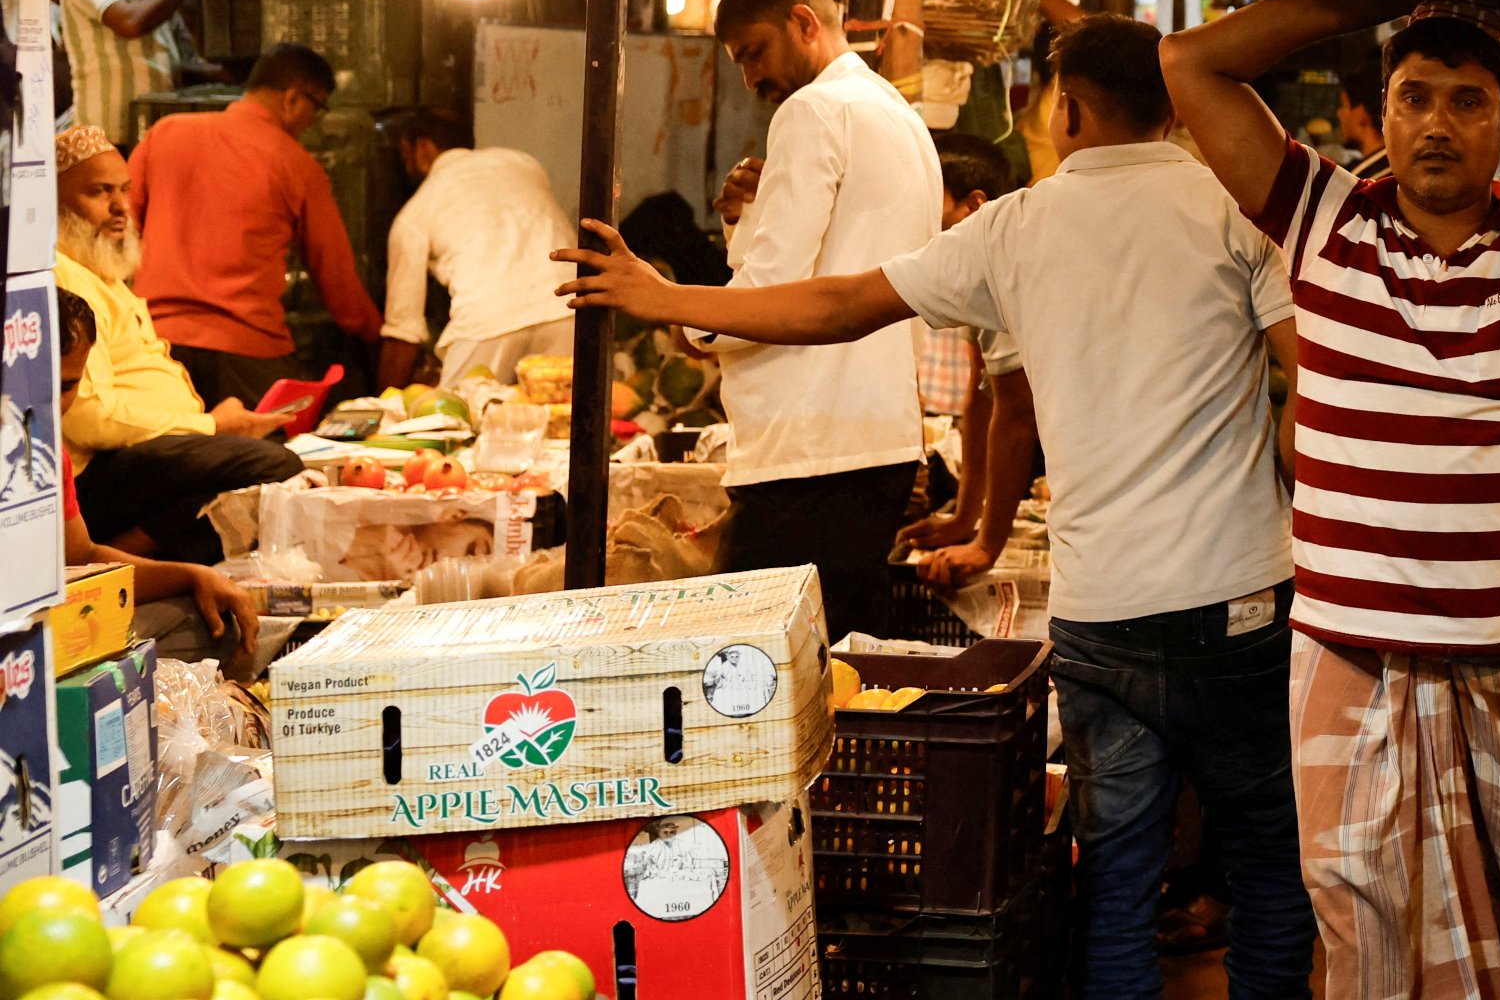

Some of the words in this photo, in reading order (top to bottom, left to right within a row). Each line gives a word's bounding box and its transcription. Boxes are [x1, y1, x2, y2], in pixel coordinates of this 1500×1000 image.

[287, 708, 335, 719] Produce
[732, 704, 751, 712] 1960
[283, 725, 295, 736] Of
[299, 723, 341, 736] Türkiye
[475, 731, 511, 762] 1824
[428, 762, 484, 780] REAL
[391, 788, 501, 828] APPLE
[506, 776, 674, 820] MASTER
[664, 901, 691, 913] 1960
